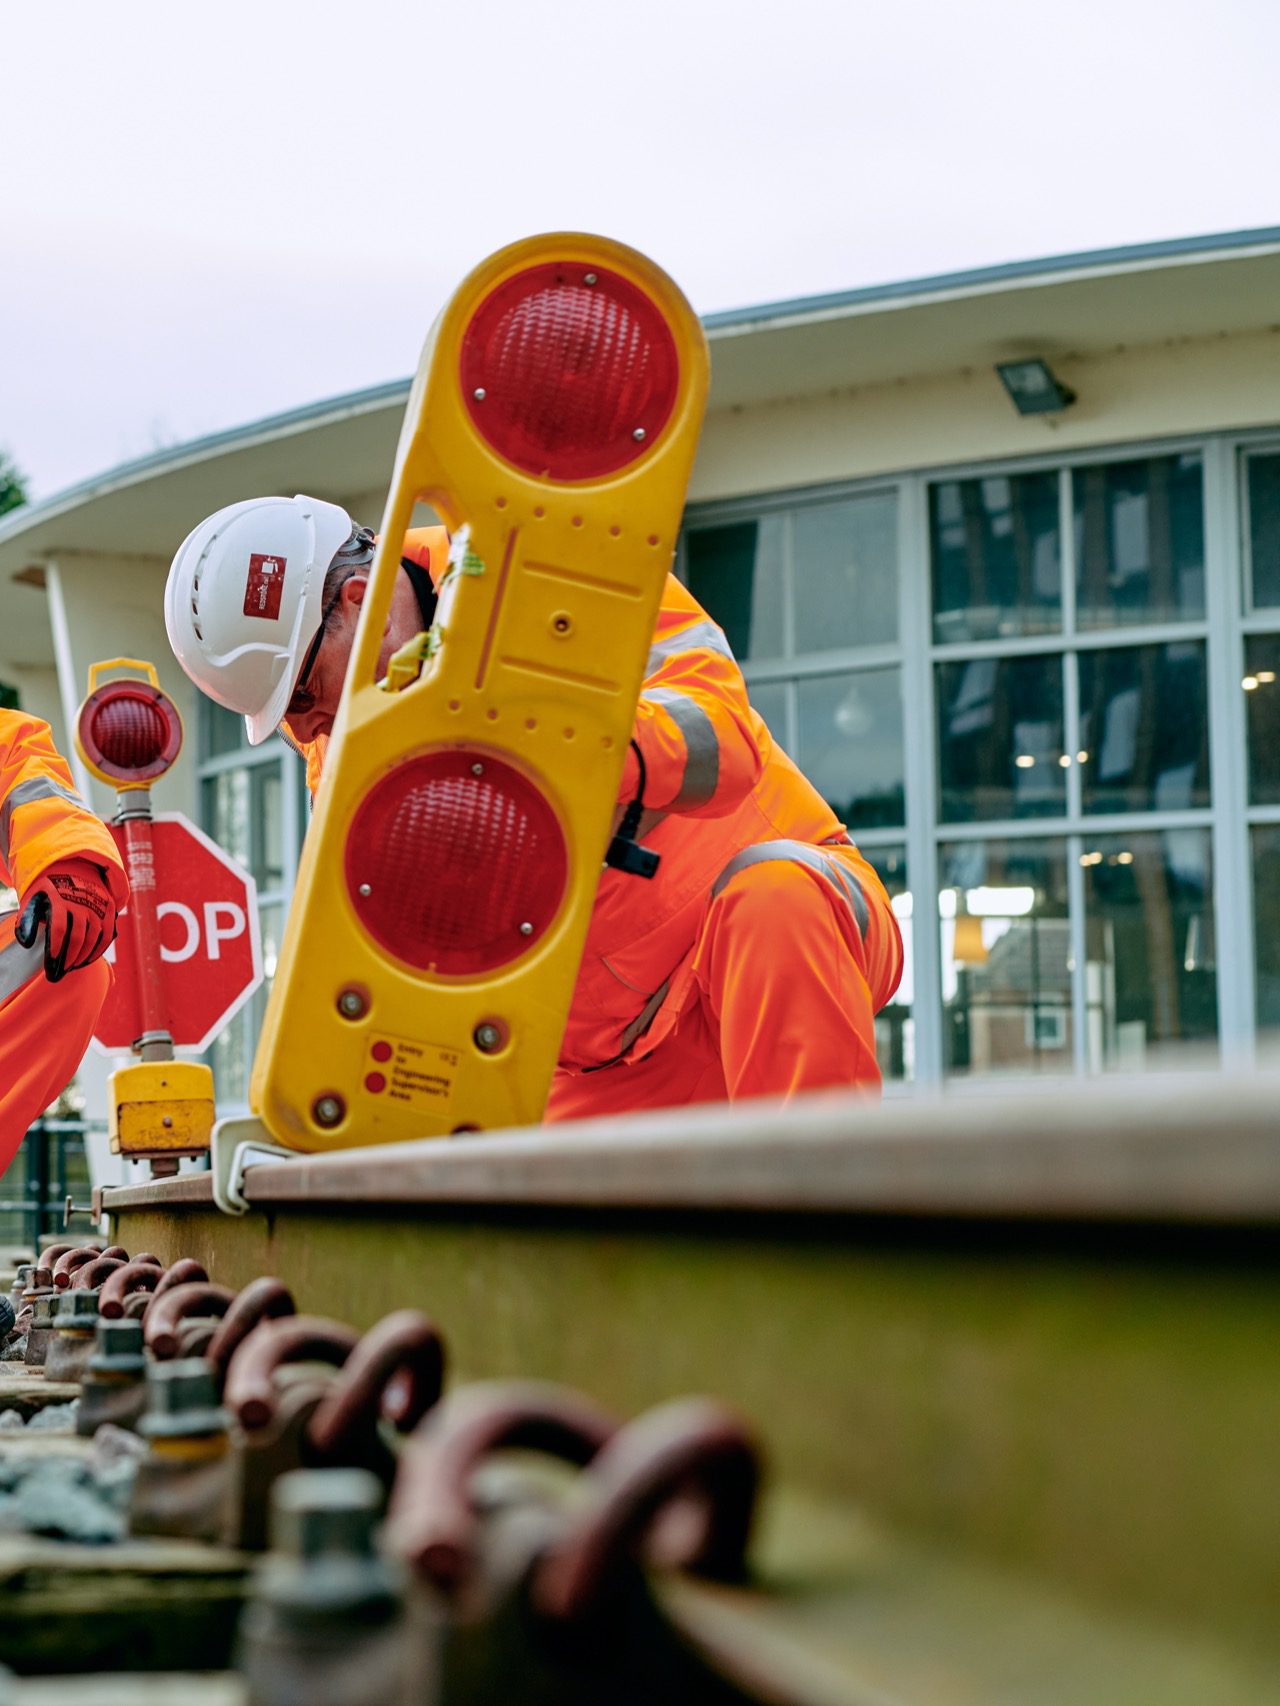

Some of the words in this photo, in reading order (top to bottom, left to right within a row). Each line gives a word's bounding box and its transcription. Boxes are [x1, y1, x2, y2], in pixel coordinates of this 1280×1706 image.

[104, 900, 247, 962] OP
[398, 1043, 423, 1058] Entry
[393, 1065, 450, 1088] Engineering
[388, 1089, 411, 1101] Area
[391, 1077, 449, 1098] Supervisor's
